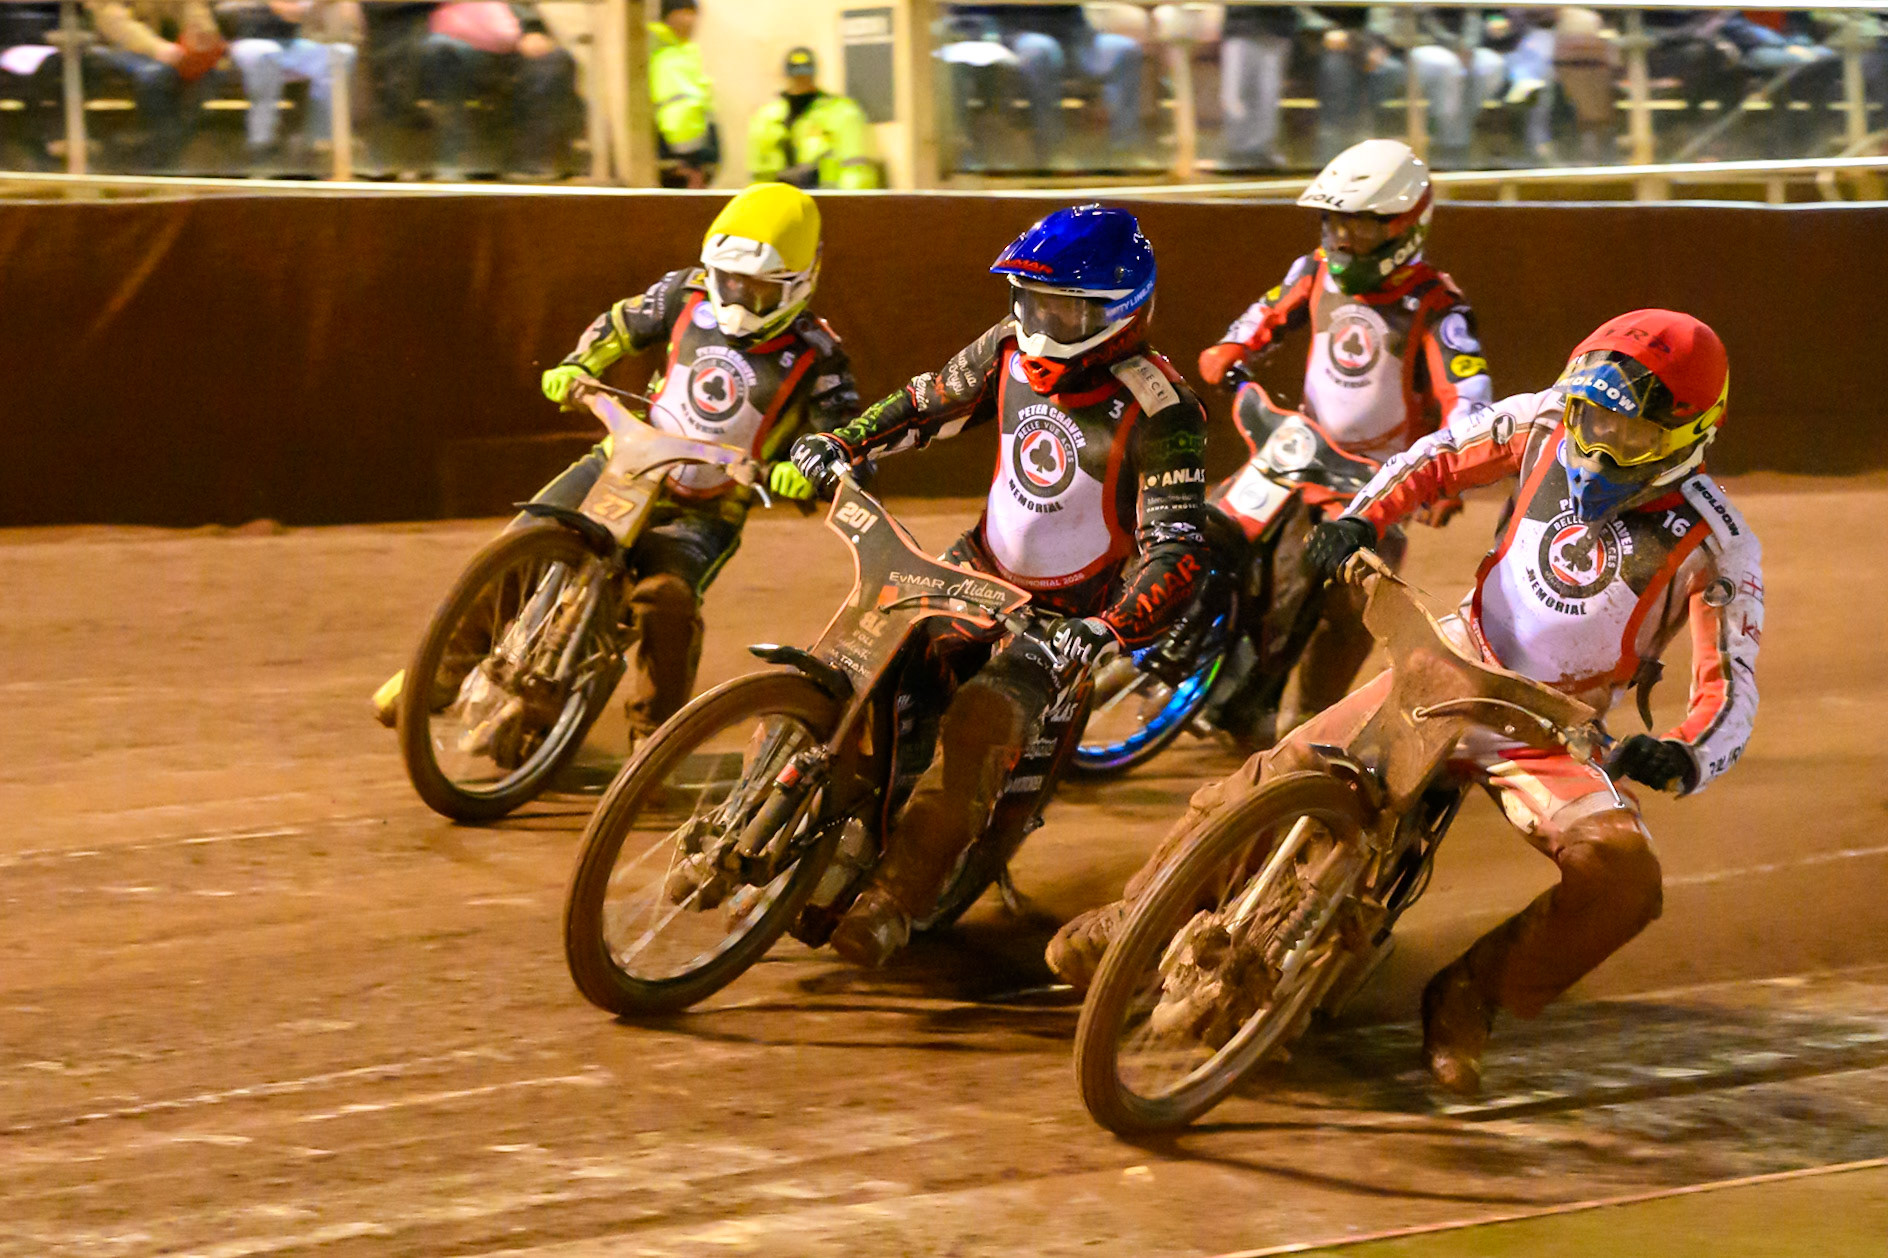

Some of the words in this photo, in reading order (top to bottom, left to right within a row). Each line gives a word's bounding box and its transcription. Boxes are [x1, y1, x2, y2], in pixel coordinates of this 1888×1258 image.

[1108, 399, 1125, 419] 3
[1018, 404, 1048, 420] PETER
[1049, 407, 1087, 448] CRAVEN
[1018, 420, 1040, 440] BELLE
[1044, 421, 1060, 436] VUE
[1009, 478, 1063, 513] MEMORIAL
[835, 501, 879, 534] 201
[1662, 509, 1691, 538] 16
[1526, 566, 1587, 615] MEMORIAL
